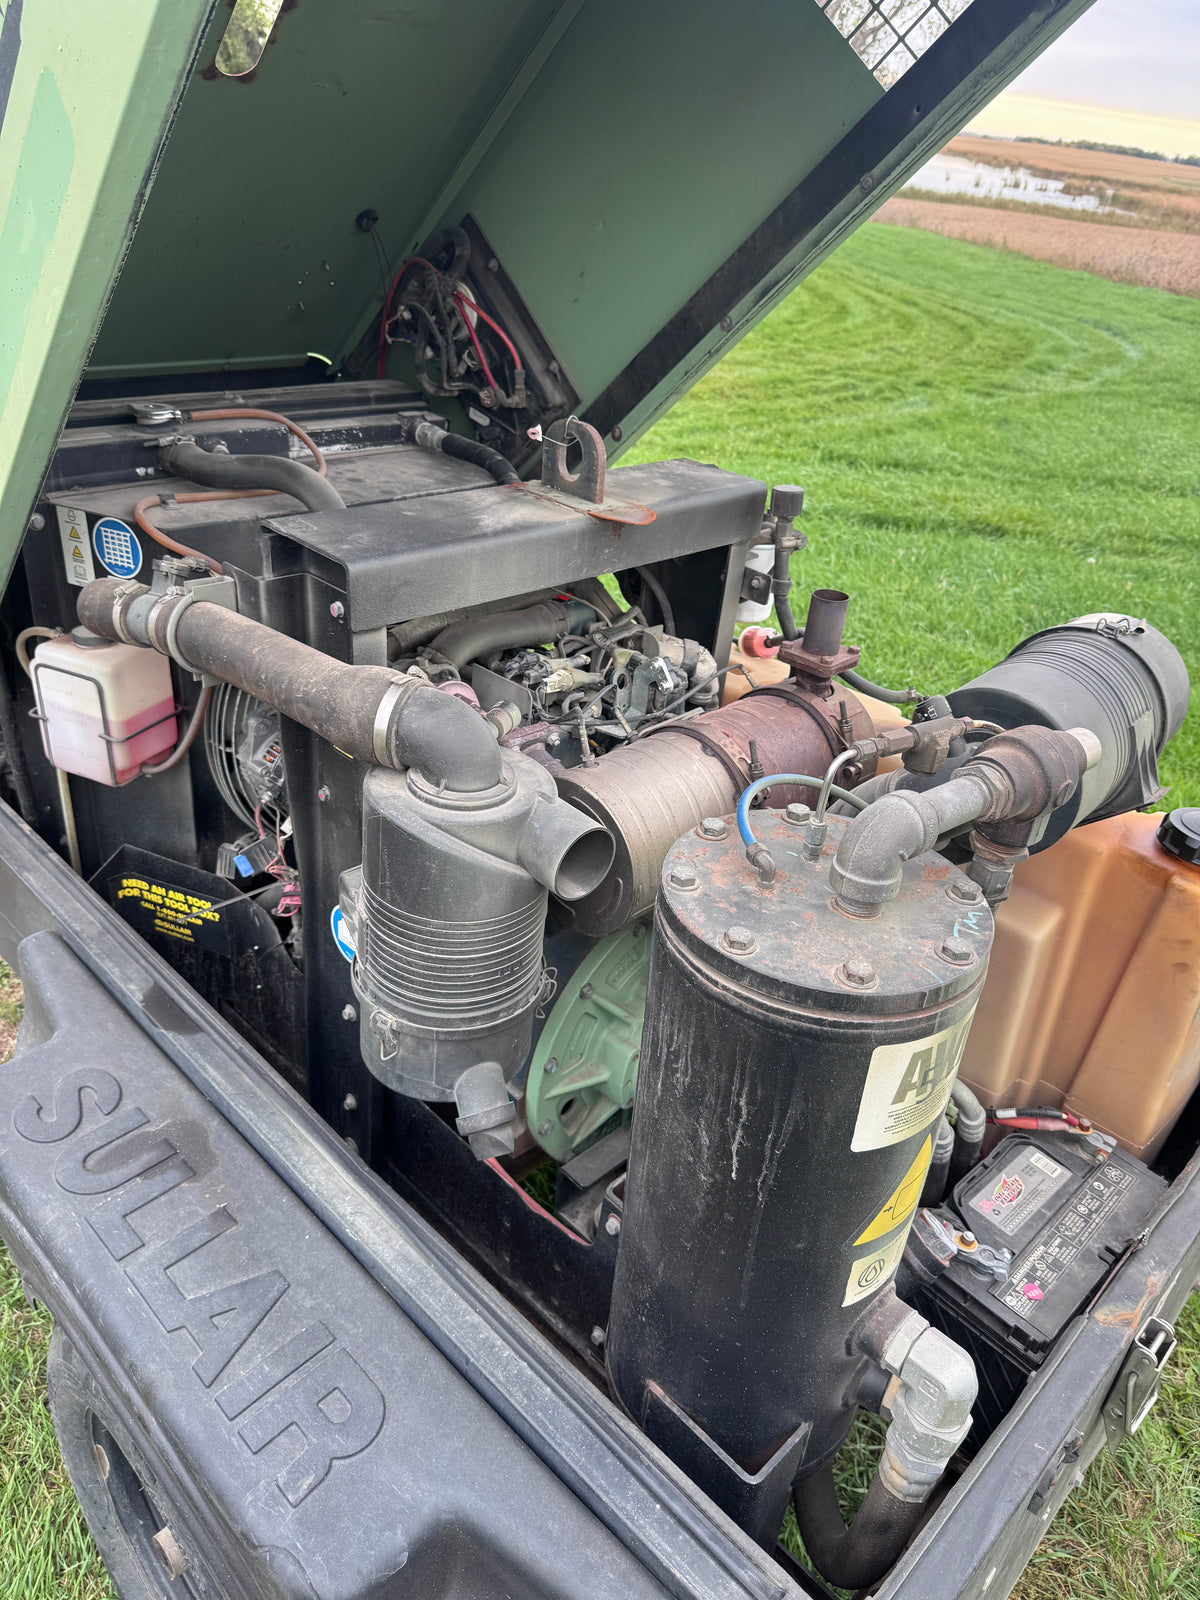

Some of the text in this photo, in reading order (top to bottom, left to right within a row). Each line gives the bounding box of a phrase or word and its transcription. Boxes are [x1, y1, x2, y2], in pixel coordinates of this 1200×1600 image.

[117, 888, 141, 899] FOR
[142, 890, 163, 904] THIS
[164, 897, 191, 914] TOOL
[122, 879, 149, 890] NEED
[151, 885, 166, 896] AN
[167, 890, 186, 903] AIR
[140, 900, 156, 910] CALL
[994, 1177, 1020, 1202] INTERSTATE
[1000, 1183, 1023, 1206] BATTERIES
[14, 1068, 387, 1508] SULLAIR
